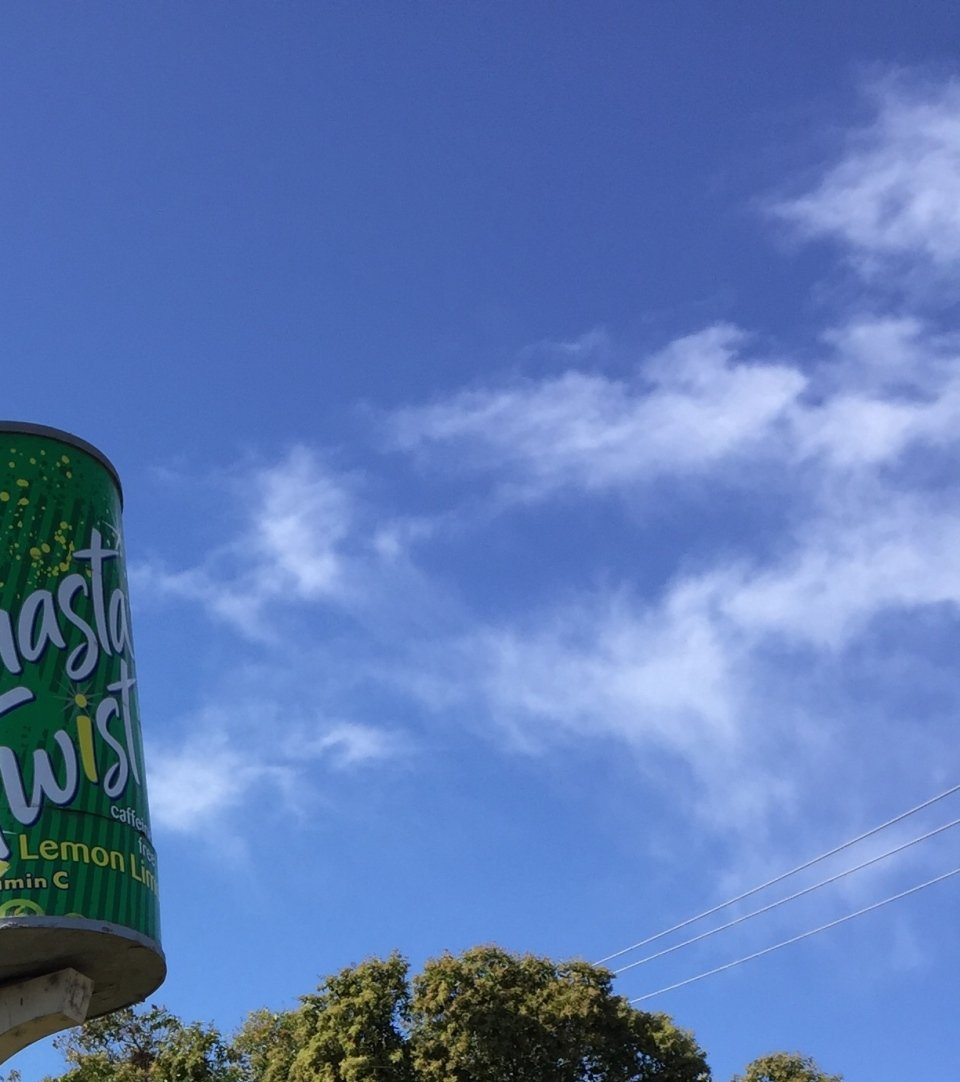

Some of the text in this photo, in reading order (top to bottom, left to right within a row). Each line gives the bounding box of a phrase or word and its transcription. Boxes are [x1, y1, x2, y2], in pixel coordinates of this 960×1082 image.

[20, 834, 158, 897] Lemon Lim
[52, 870, 69, 890] C
